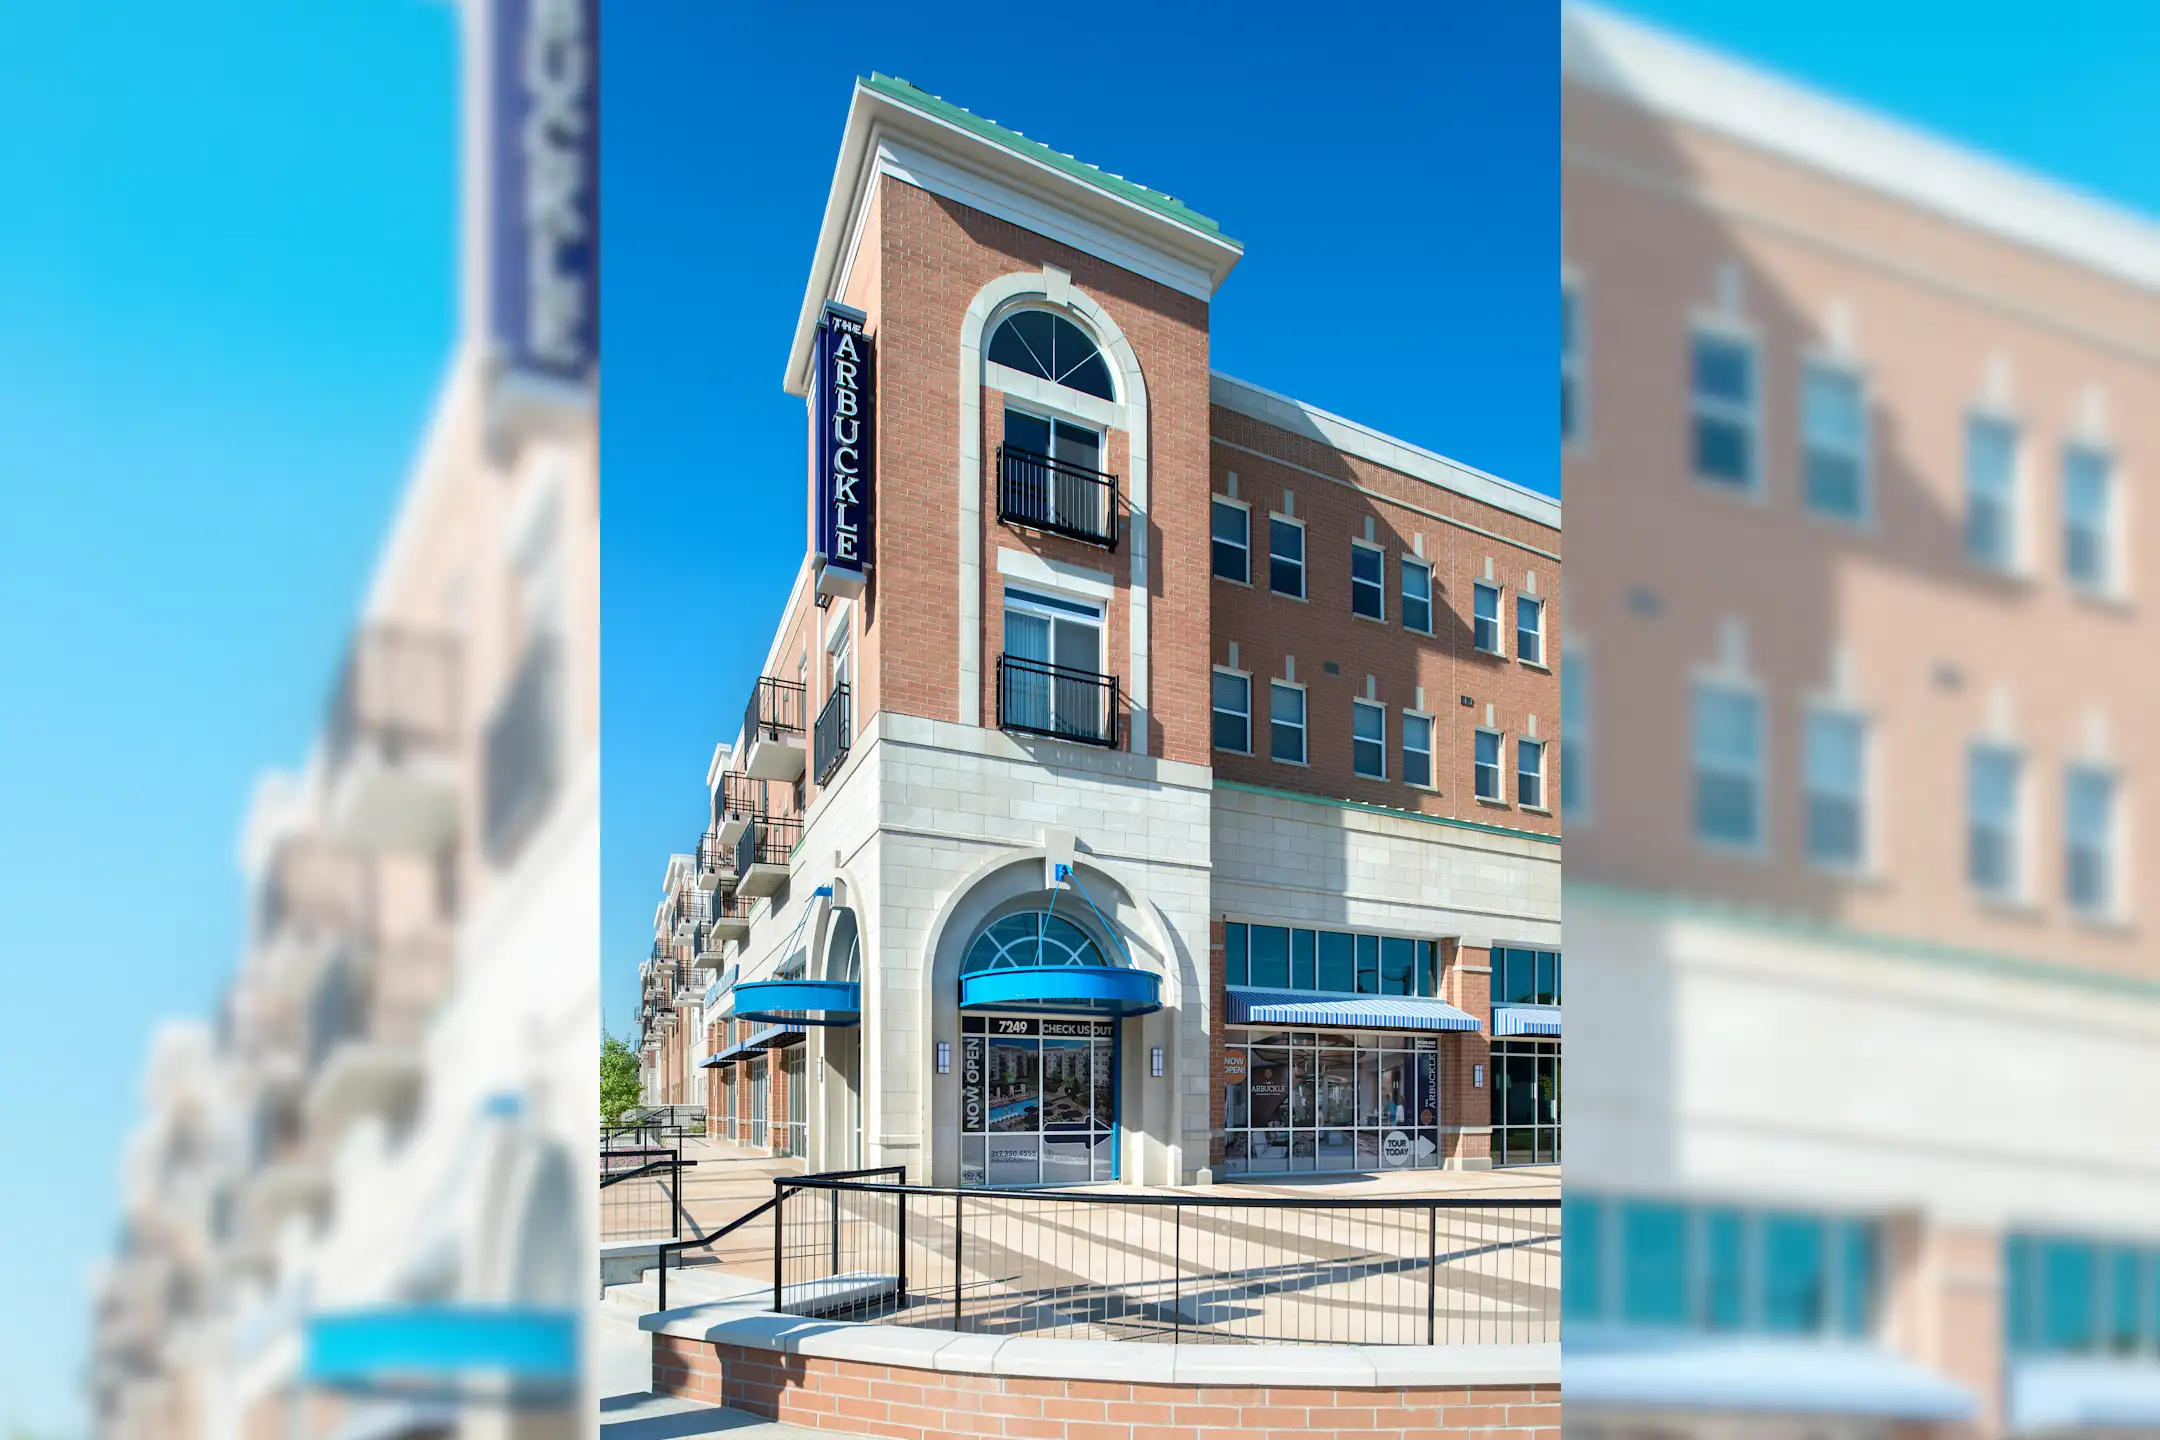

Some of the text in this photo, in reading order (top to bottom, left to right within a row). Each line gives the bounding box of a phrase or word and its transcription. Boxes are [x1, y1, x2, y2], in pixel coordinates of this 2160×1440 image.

[832, 317, 862, 335] THE
[833, 333, 860, 560] ARBUCKLE
[998, 1020, 1028, 1033] 7249
[1043, 1023, 1113, 1036] CHECK US OUT
[1224, 1057, 1244, 1065] NOW
[1223, 1066, 1246, 1074] OPEN!
[966, 1038, 979, 1128] NOW OPEN
[1428, 1054, 1436, 1108] ARBUCKLE
[1251, 1085, 1286, 1093] ARBUCKLE
[1387, 1139, 1407, 1147] TOUR
[1385, 1148, 1409, 1156] TODAY
